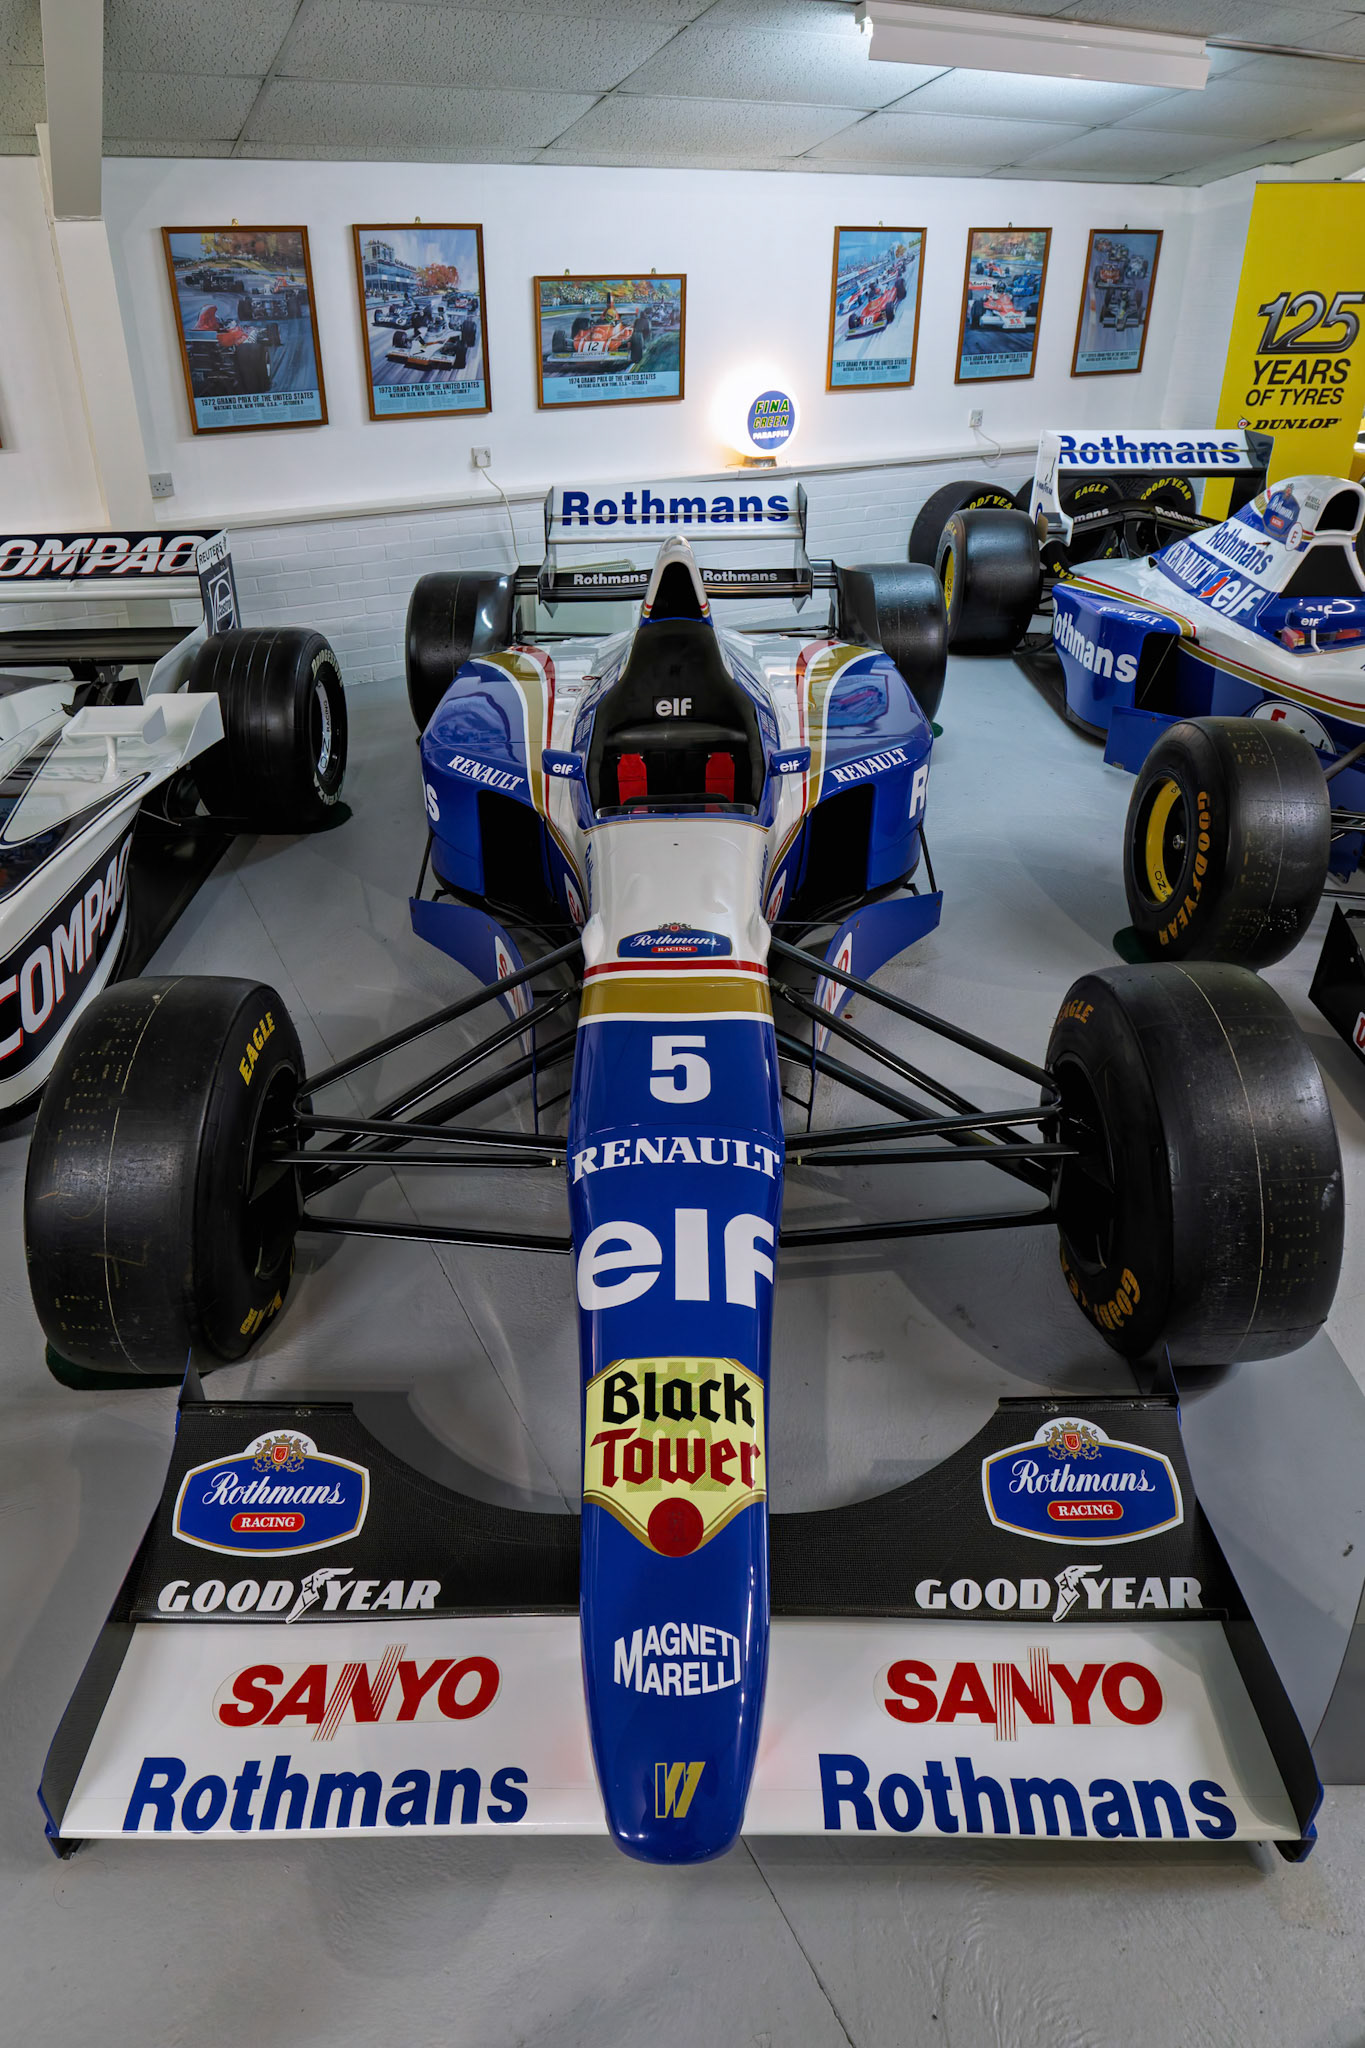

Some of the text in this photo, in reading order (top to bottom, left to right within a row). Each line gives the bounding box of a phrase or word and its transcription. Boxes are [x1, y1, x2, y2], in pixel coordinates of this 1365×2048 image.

[1256, 290, 1365, 355] 125
[587, 342, 599, 352] 12
[393, 385, 411, 393] GRAND
[1253, 358, 1351, 385] YEARS
[216, 397, 236, 405] GRAND
[238, 396, 251, 404] PRIX
[272, 393, 292, 401] UNITED
[293, 392, 314, 400] STATES
[755, 399, 789, 414] FINA
[1245, 388, 1344, 406] OF TYRES
[753, 415, 789, 429] GREEN
[1253, 418, 1340, 430] DUNLOP
[1058, 435, 1241, 464] Rothmans
[562, 489, 790, 526] Rothmans
[1075, 484, 1109, 499] EAGLE
[0, 535, 207, 577] OMPAQ
[1162, 540, 1220, 590] RENAULT
[1206, 522, 1274, 575] Rothmans
[573, 572, 648, 586] Rothmans
[703, 570, 778, 583] Rothmans
[1211, 578, 1267, 618] elf
[1301, 617, 1320, 627] elf
[655, 698, 692, 716] elf
[447, 755, 525, 791] RENAULT
[552, 763, 573, 776] elf
[779, 759, 799, 773] elf
[829, 747, 909, 783] RENAULT
[1154, 870, 1167, 890] OZ
[1158, 791, 1211, 945] GOODYEAR
[630, 933, 721, 947] Rothmans
[239, 1011, 275, 1086] EAGLE
[650, 1035, 711, 1104] 5
[572, 1136, 780, 1184] RENAULT
[577, 1208, 774, 1311] elf
[602, 1370, 755, 1428] Black
[590, 1428, 761, 1489] Tower
[202, 1471, 346, 1506] Rothmans
[1009, 1459, 1155, 1495] Rothmans
[240, 1516, 296, 1528] RACING
[1057, 1505, 1114, 1516] RACING
[158, 1574, 441, 1618] GOODYEAR
[915, 1571, 1203, 1615] GOODYEAR
[614, 1622, 742, 1664] MAGNETI
[218, 1644, 500, 1740] SANYO
[614, 1655, 742, 1696] MARELLI
[884, 1648, 1163, 1740] SANYO
[122, 1755, 529, 1835] Rothmans
[818, 1753, 1237, 1840] Rothmans
